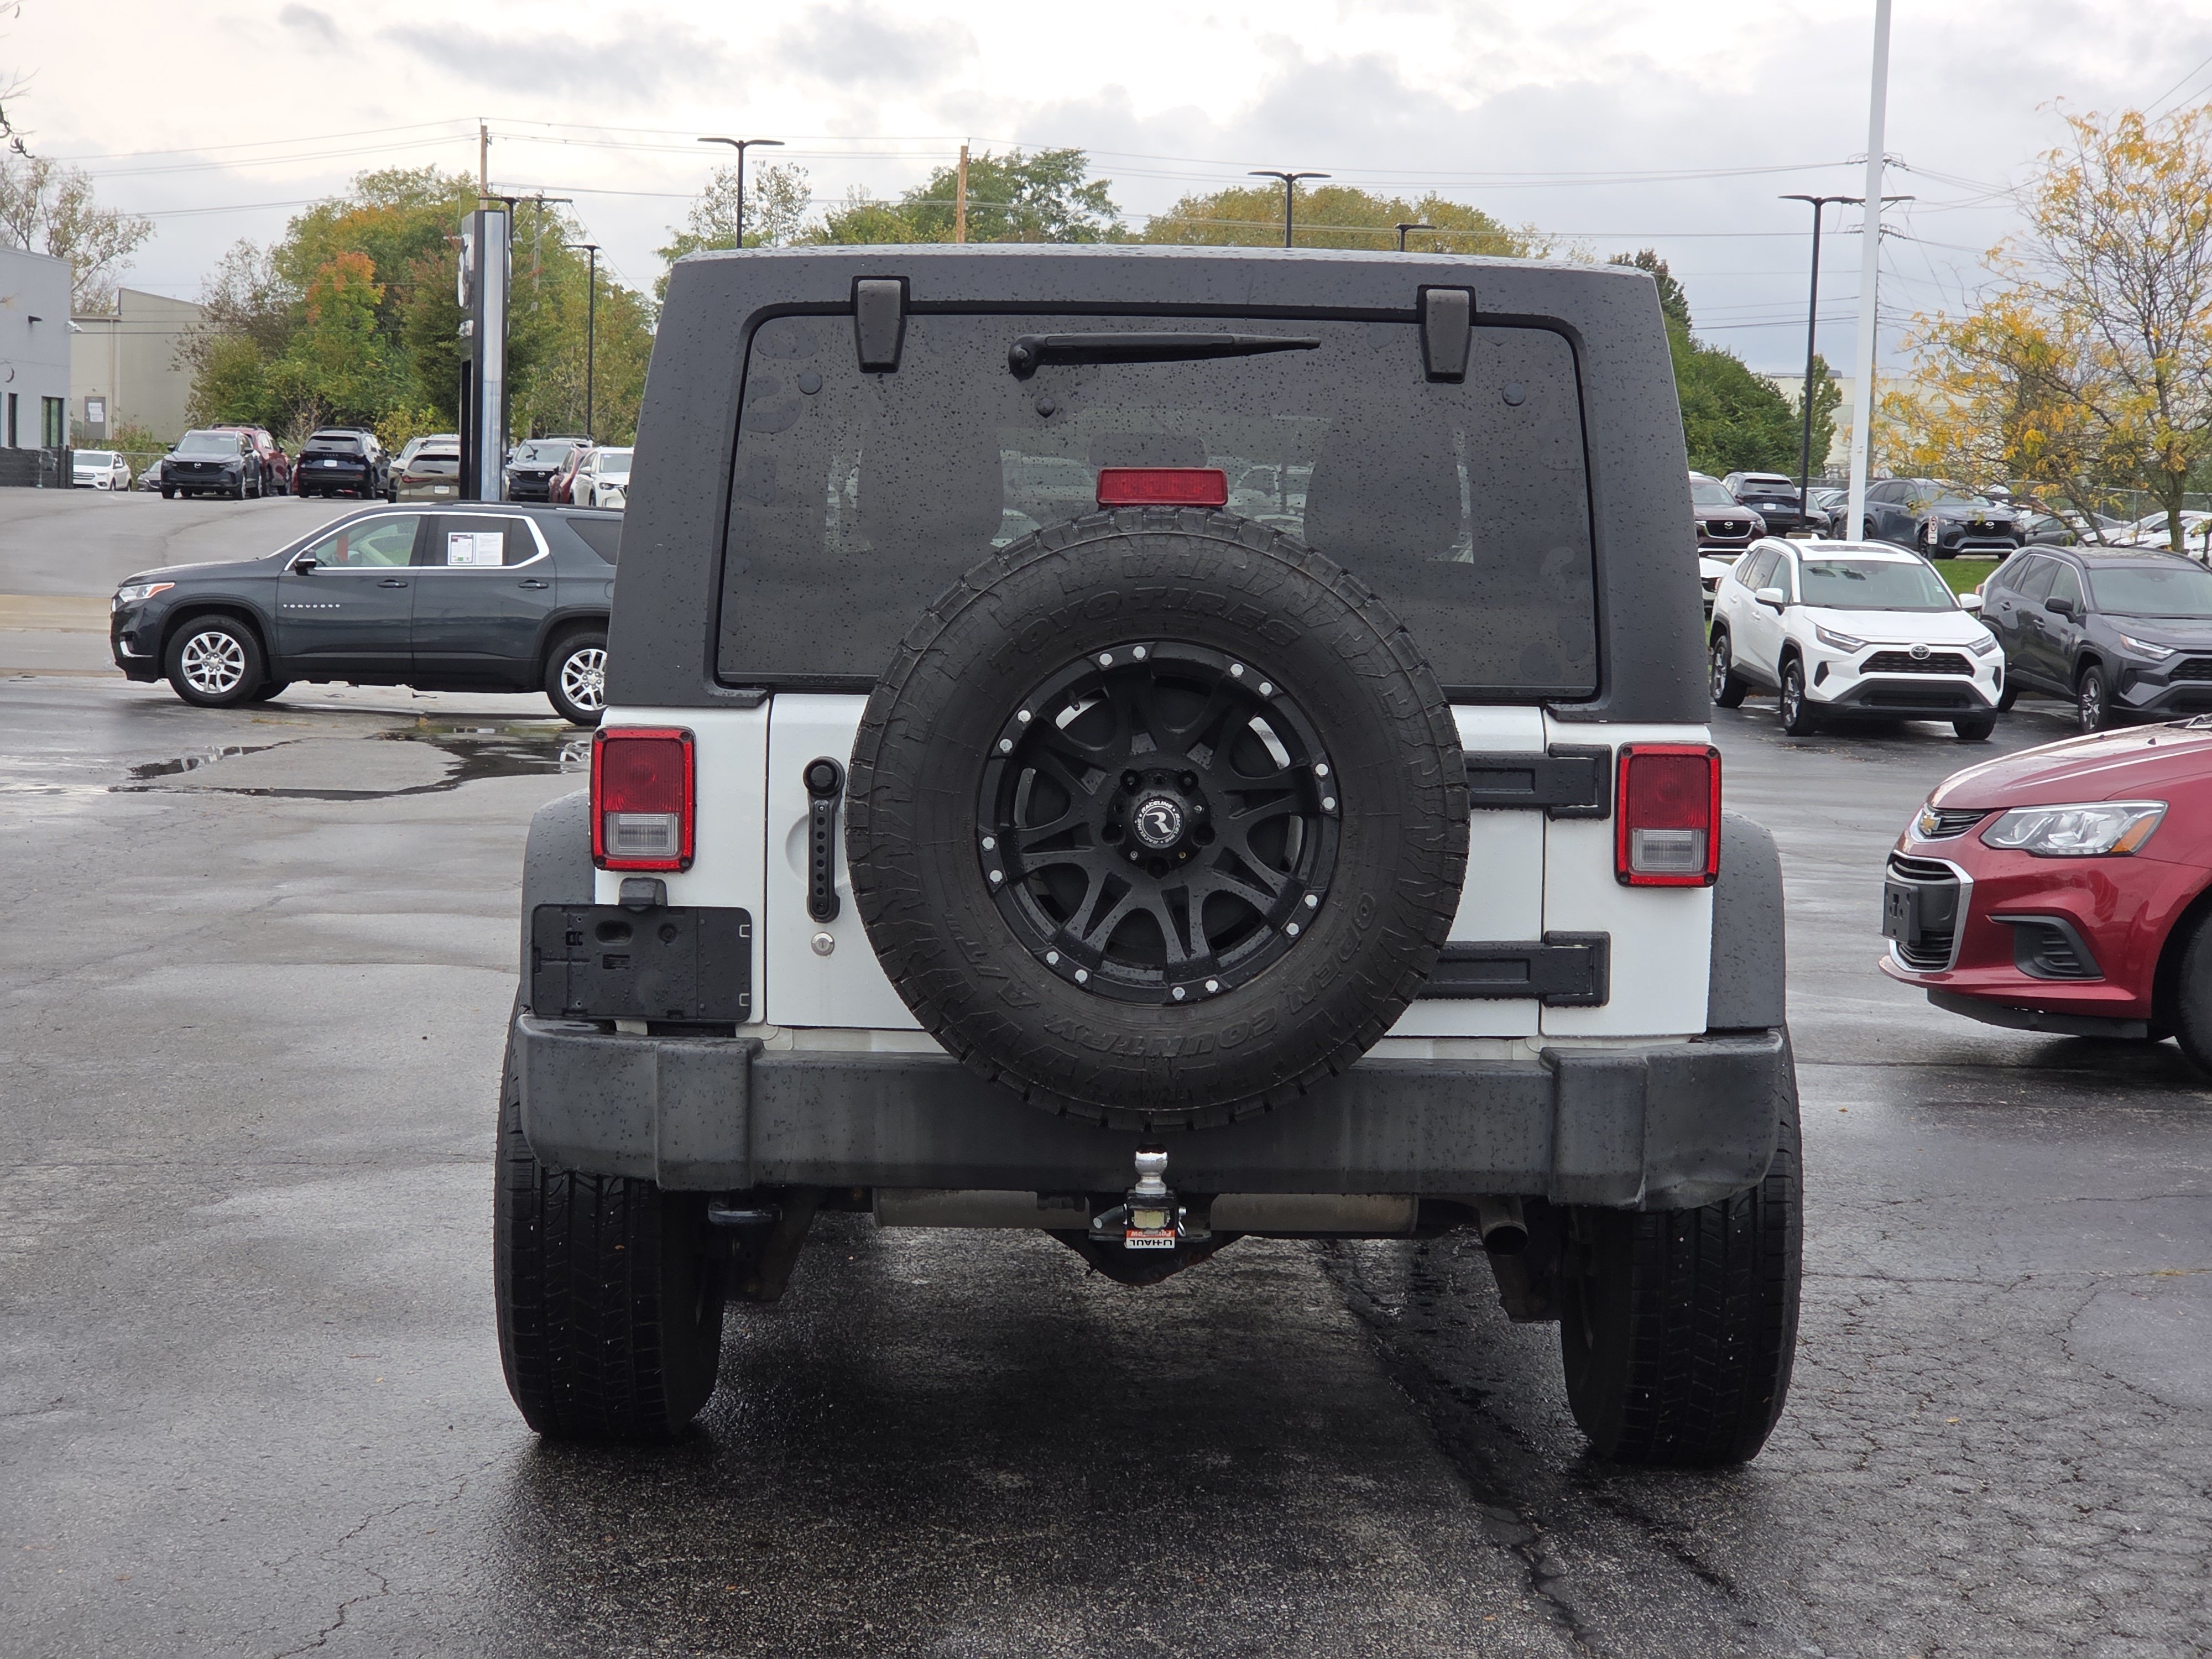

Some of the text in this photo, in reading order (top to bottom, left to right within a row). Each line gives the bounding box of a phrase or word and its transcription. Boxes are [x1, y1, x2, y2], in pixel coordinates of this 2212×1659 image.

[987, 586, 1301, 675] TOYO TIRES
[1141, 801, 1173, 813] RACELINE
[1288, 893, 1376, 1014] OPEN
[1044, 1006, 1277, 1057] COUNTRY
